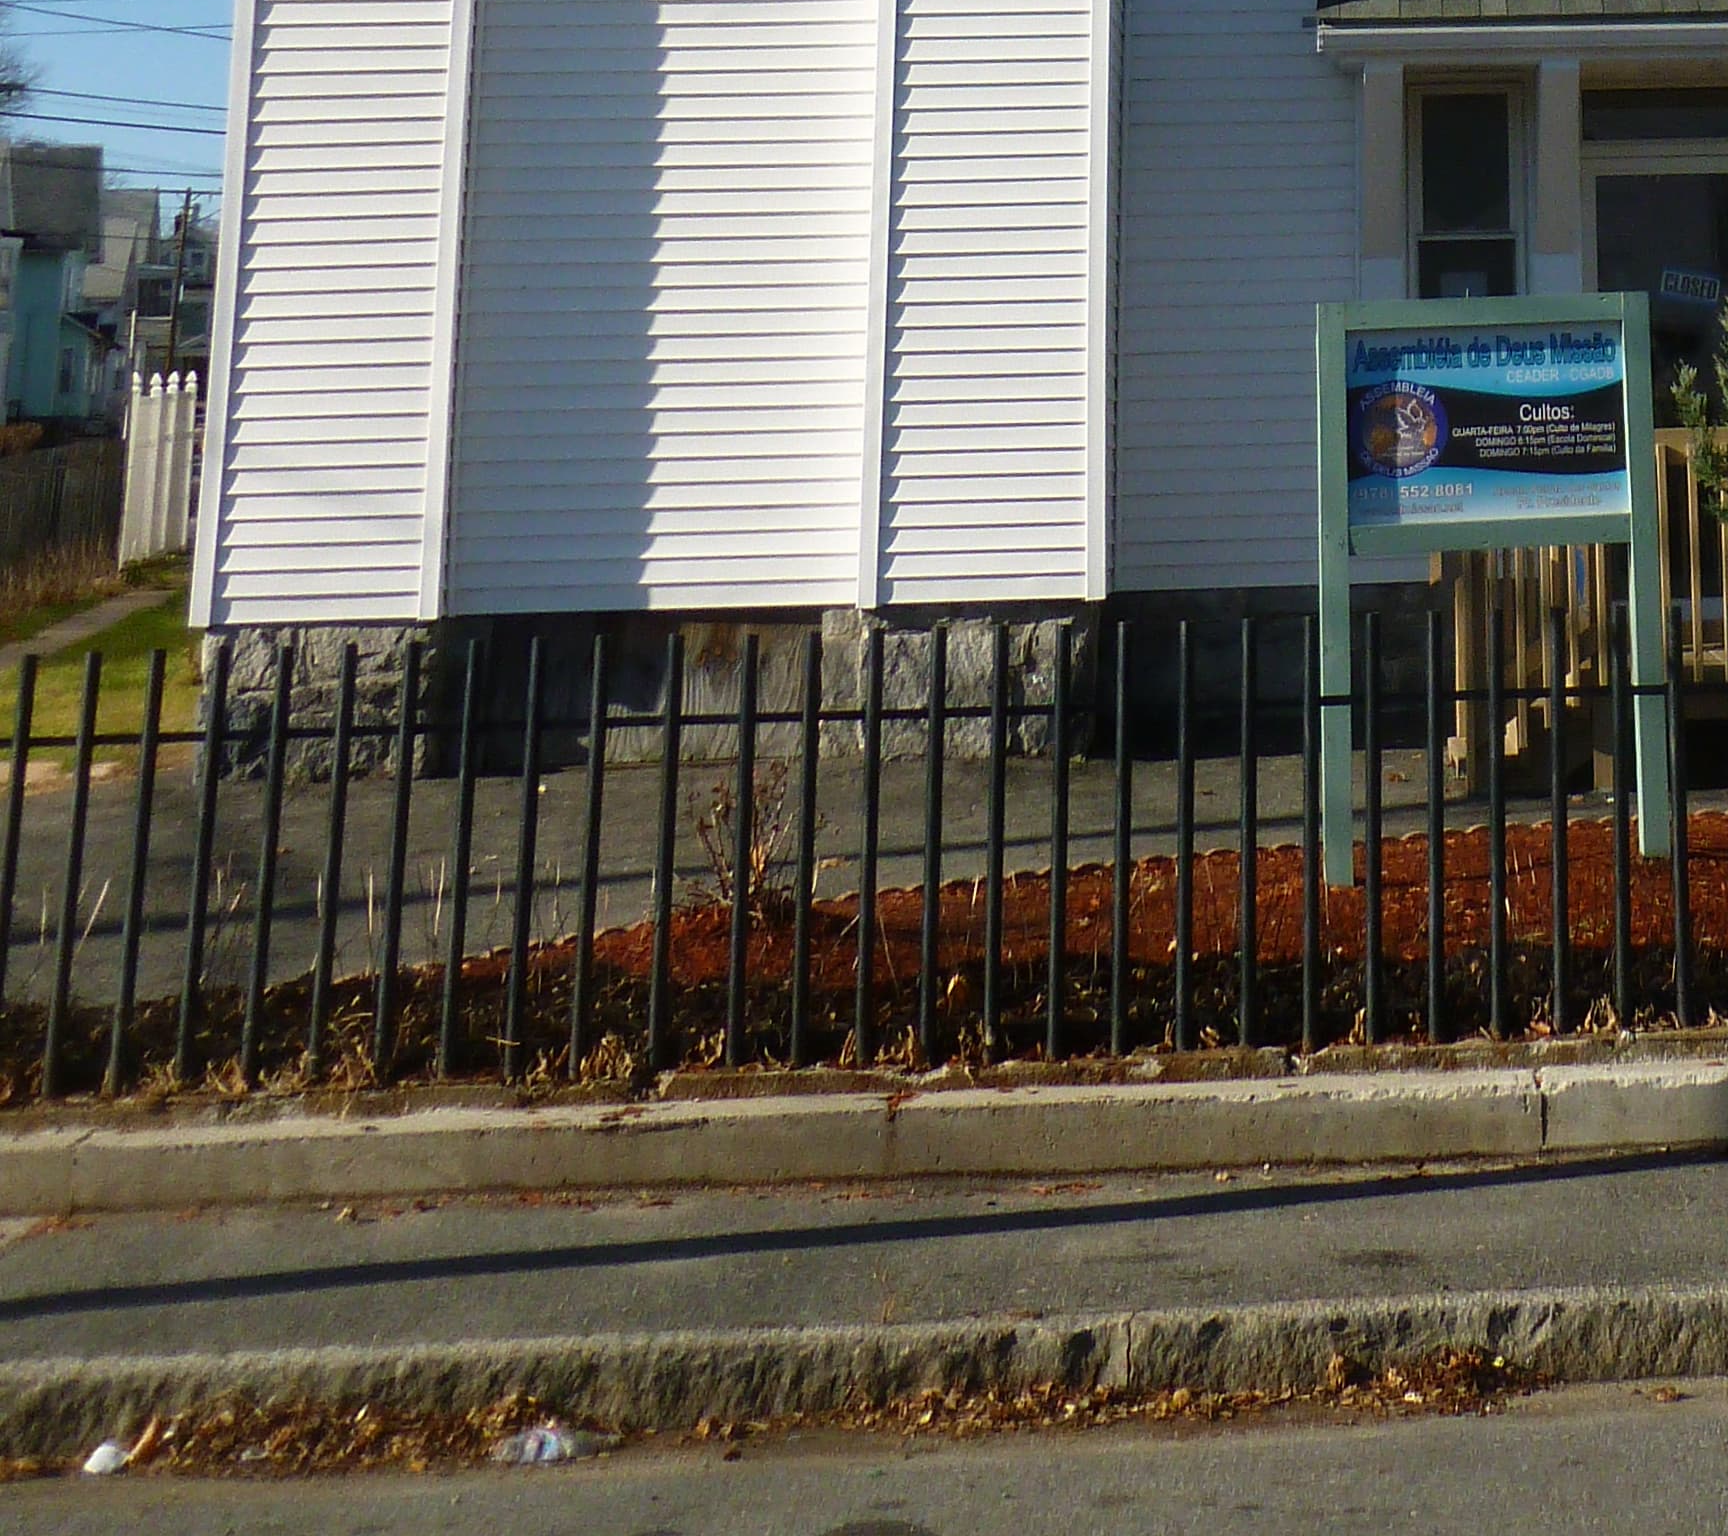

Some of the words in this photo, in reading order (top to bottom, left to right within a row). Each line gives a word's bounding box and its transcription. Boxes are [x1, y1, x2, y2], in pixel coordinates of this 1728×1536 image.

[1467, 336, 1491, 368] de
[1496, 335, 1545, 366] Deus
[1550, 332, 1616, 363] Missão
[1519, 403, 1575, 421] Cultos:
[1400, 486, 1429, 498] 552
